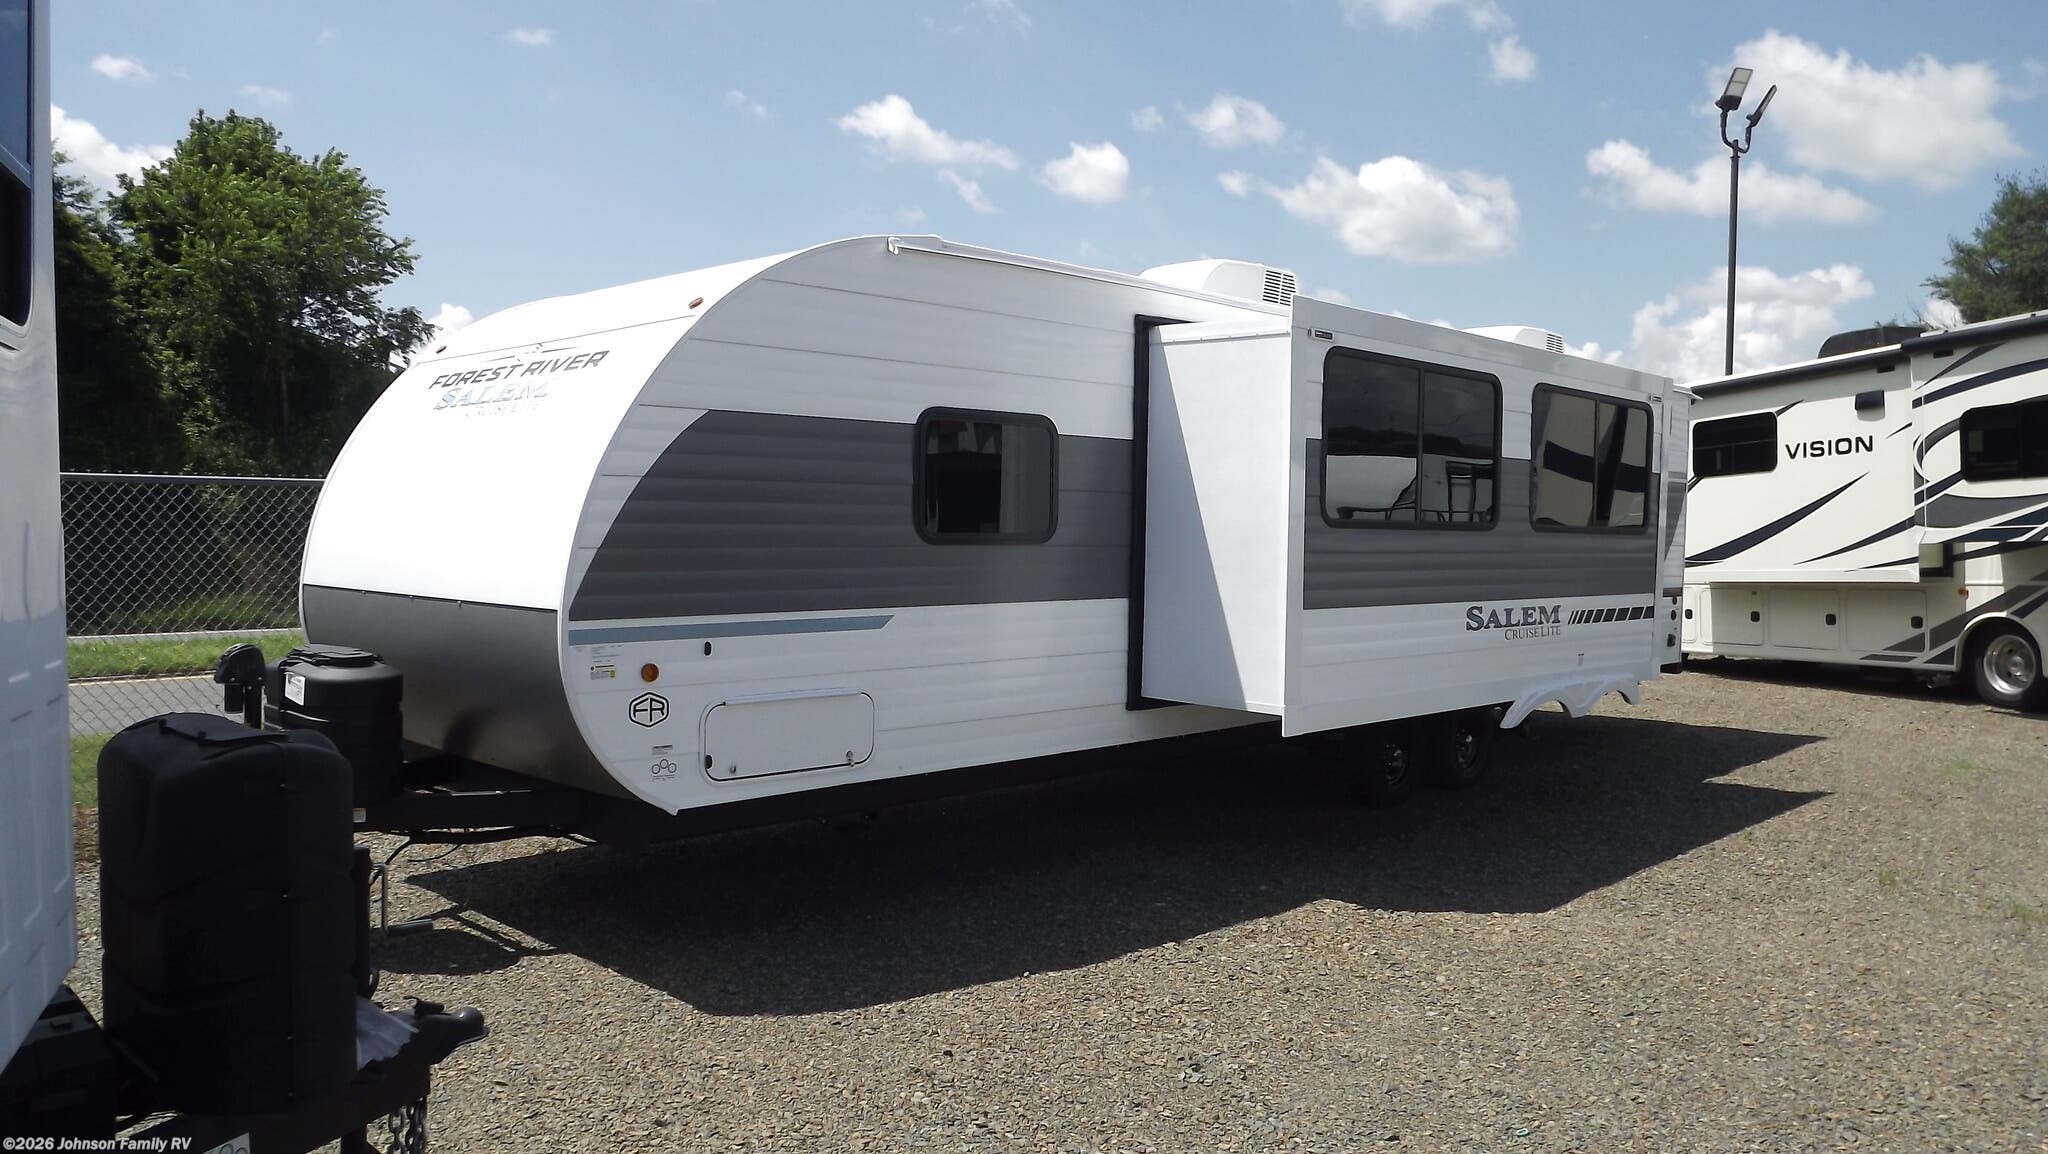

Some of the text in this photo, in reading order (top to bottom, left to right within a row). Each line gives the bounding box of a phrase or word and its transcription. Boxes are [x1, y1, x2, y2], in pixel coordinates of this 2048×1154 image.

[428, 350, 610, 390] FOREST RIVER
[1785, 435, 1873, 459] VISION
[1466, 604, 1561, 631] SALEM
